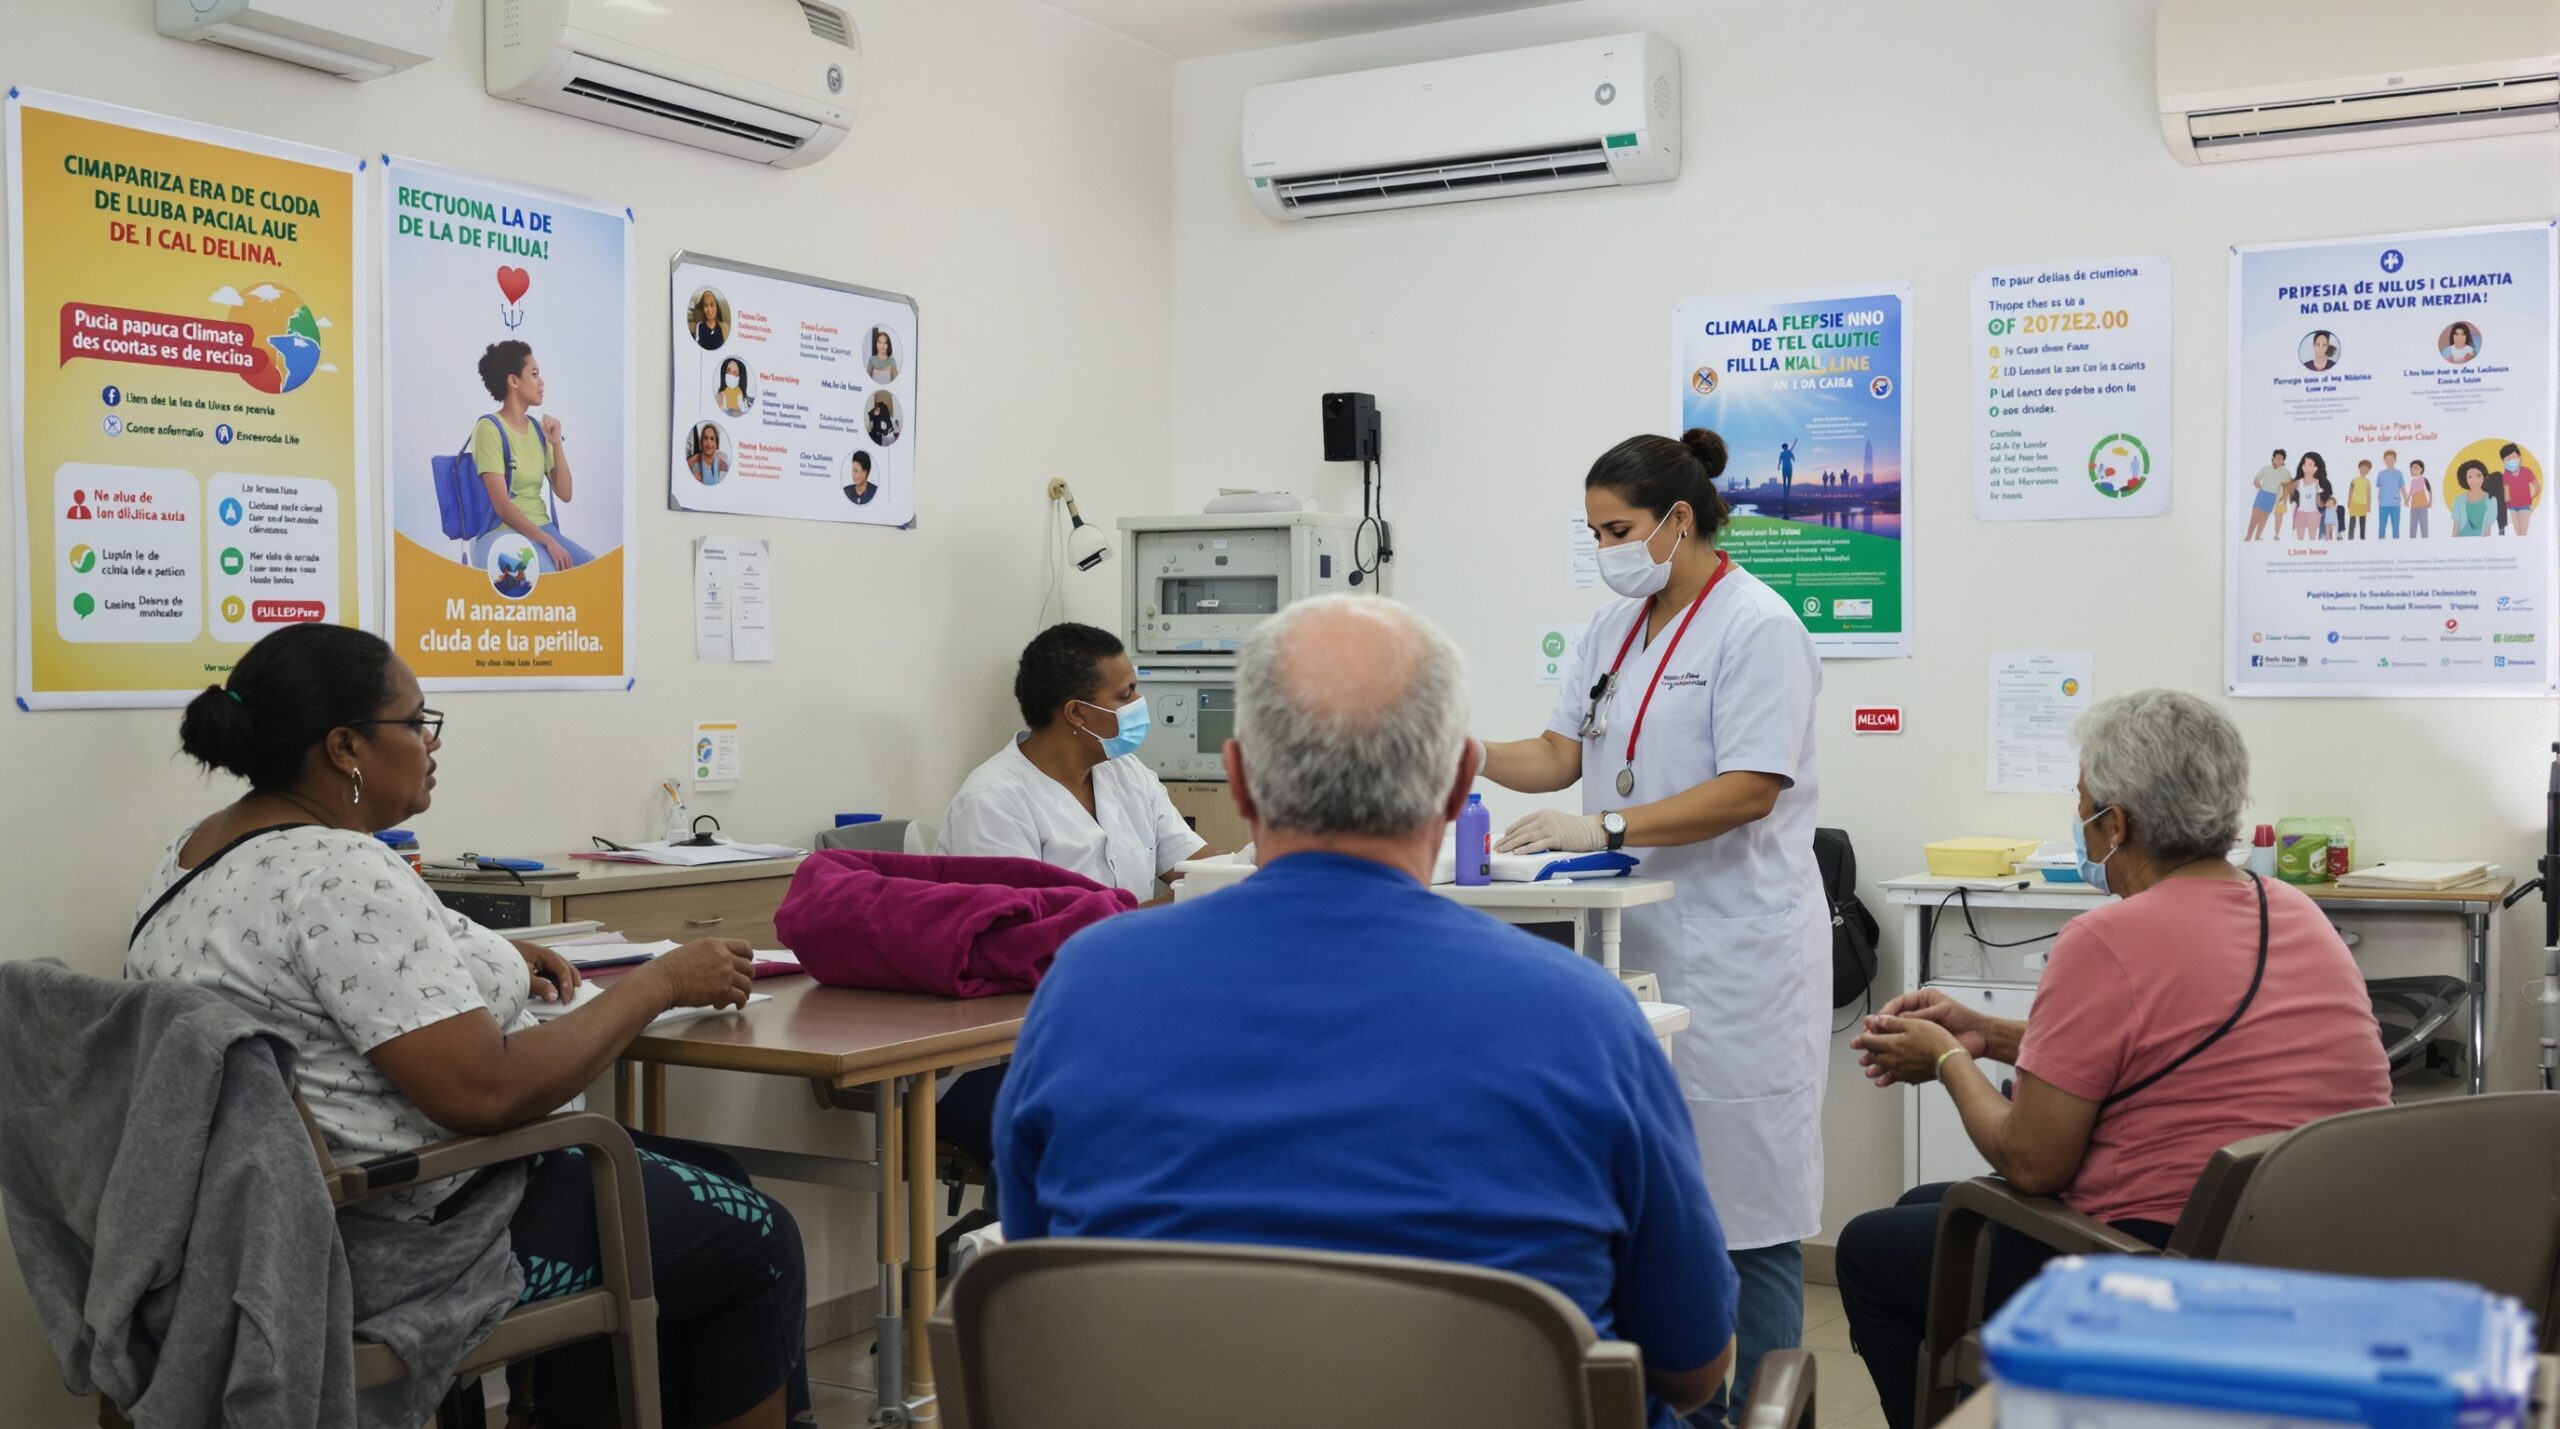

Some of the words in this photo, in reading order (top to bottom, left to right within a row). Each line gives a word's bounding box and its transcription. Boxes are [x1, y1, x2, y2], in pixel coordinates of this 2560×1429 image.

[64, 154, 183, 194] CIMAPARIZA
[190, 178, 226, 201] ERA
[232, 185, 255, 207] DE
[260, 191, 320, 219] CLODA
[95, 190, 120, 212] DE
[193, 206, 257, 235] PACIAL
[262, 218, 297, 241] AUE
[399, 186, 496, 223] RECTUONA
[502, 206, 524, 228] LA
[530, 212, 552, 233] DE
[110, 222, 139, 244] DE
[159, 229, 197, 253] CAL
[203, 237, 282, 267] DELINA.
[399, 215, 423, 237] DE
[430, 220, 453, 242] LA
[459, 225, 481, 247] DE
[487, 231, 549, 260] FILIUA!
[2074, 270, 2086, 280] de
[2440, 272, 2512, 288] CLIMATIA
[2301, 303, 2319, 314] NA
[2323, 301, 2349, 313] DAL
[2354, 299, 2372, 311] DE
[2376, 296, 2416, 309] AVUR
[75, 310, 118, 331] Pucia
[183, 323, 244, 346] Climate
[1706, 318, 1777, 335] CLIMALA
[1848, 310, 1884, 326] NNO
[73, 332, 100, 350] des
[161, 344, 178, 359] es
[183, 342, 202, 361] de
[1752, 338, 1772, 351] DE
[1777, 336, 1807, 350] TEL
[1990, 366, 1999, 379] 2
[1990, 388, 1998, 398] P
[420, 629, 472, 652] cluda
[478, 629, 501, 651] de
